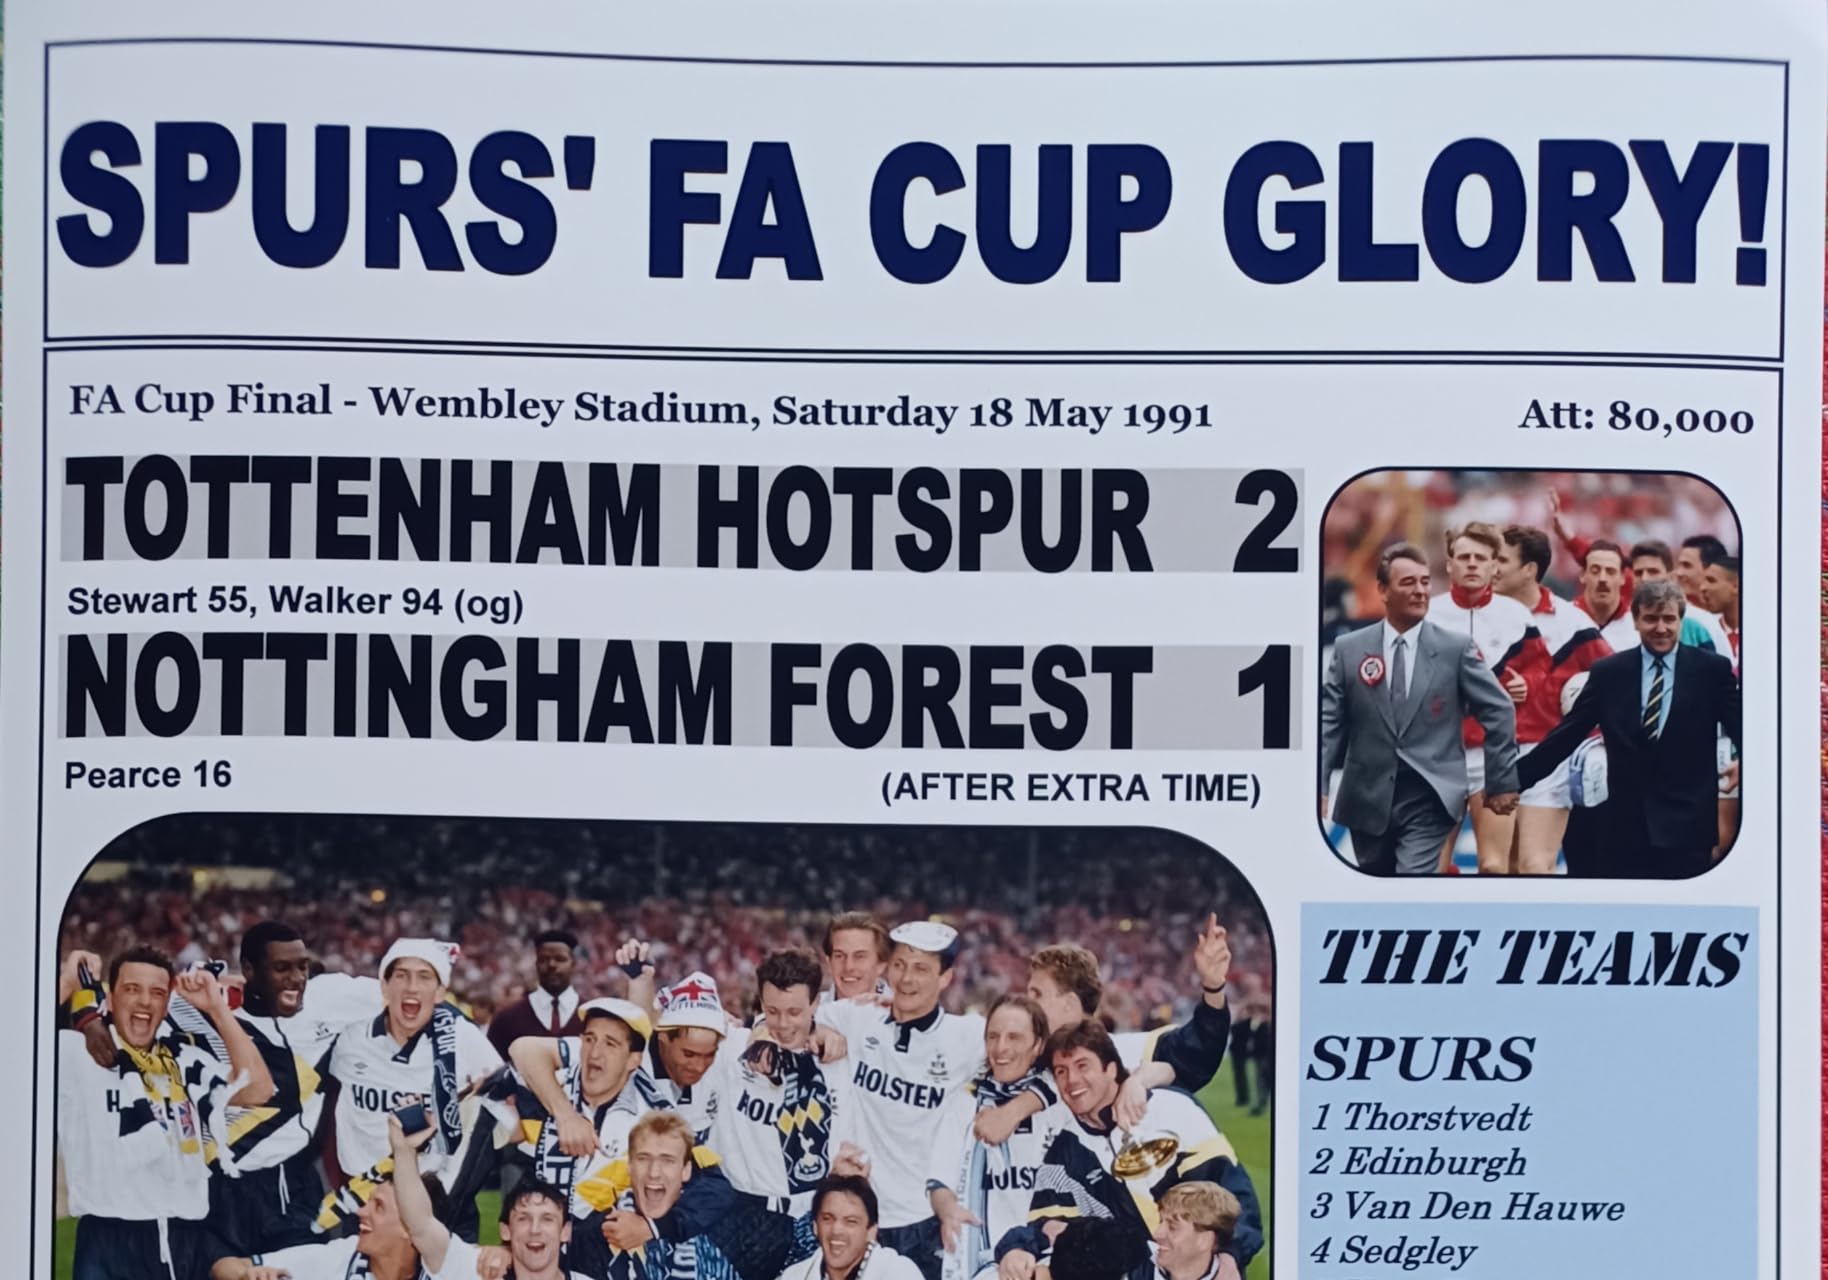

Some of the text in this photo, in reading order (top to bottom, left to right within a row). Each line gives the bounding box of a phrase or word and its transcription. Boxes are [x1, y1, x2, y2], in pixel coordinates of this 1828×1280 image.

[55, 120, 1770, 287] SPURS' FA CUP GLORY!
[69, 384, 126, 415] FA
[134, 383, 215, 422] Cup
[226, 381, 333, 415] Final
[367, 386, 565, 428] Wembley
[574, 391, 761, 432] Stadium,
[772, 394, 959, 435] Saturday
[970, 397, 1014, 428] 18
[1025, 398, 1113, 435] May
[1124, 404, 1212, 434] 1991
[1517, 399, 1754, 438] Att: 80,000
[65, 454, 1299, 574] TOTTENHAM HOTSPUR 2
[67, 585, 523, 625] Stewart 55, Walker 94 (og)
[65, 631, 1291, 752] NOTTINGHAM FOREST 1
[65, 759, 232, 790] Pearce 16
[881, 772, 1261, 809] (AFTER EXTRA TIME)
[1319, 929, 1750, 988] THE TEAMS
[1306, 1035, 1537, 1083] SPURS
[853, 1061, 945, 1110] HOLSTEN
[1311, 1102, 1533, 1132] 1 Thorstvedt
[1308, 1146, 1527, 1183] 2 Edinburgh
[1310, 1190, 1625, 1222] 3 Van Den Hauwe
[1310, 1235, 1479, 1272] 4 Sedgley
